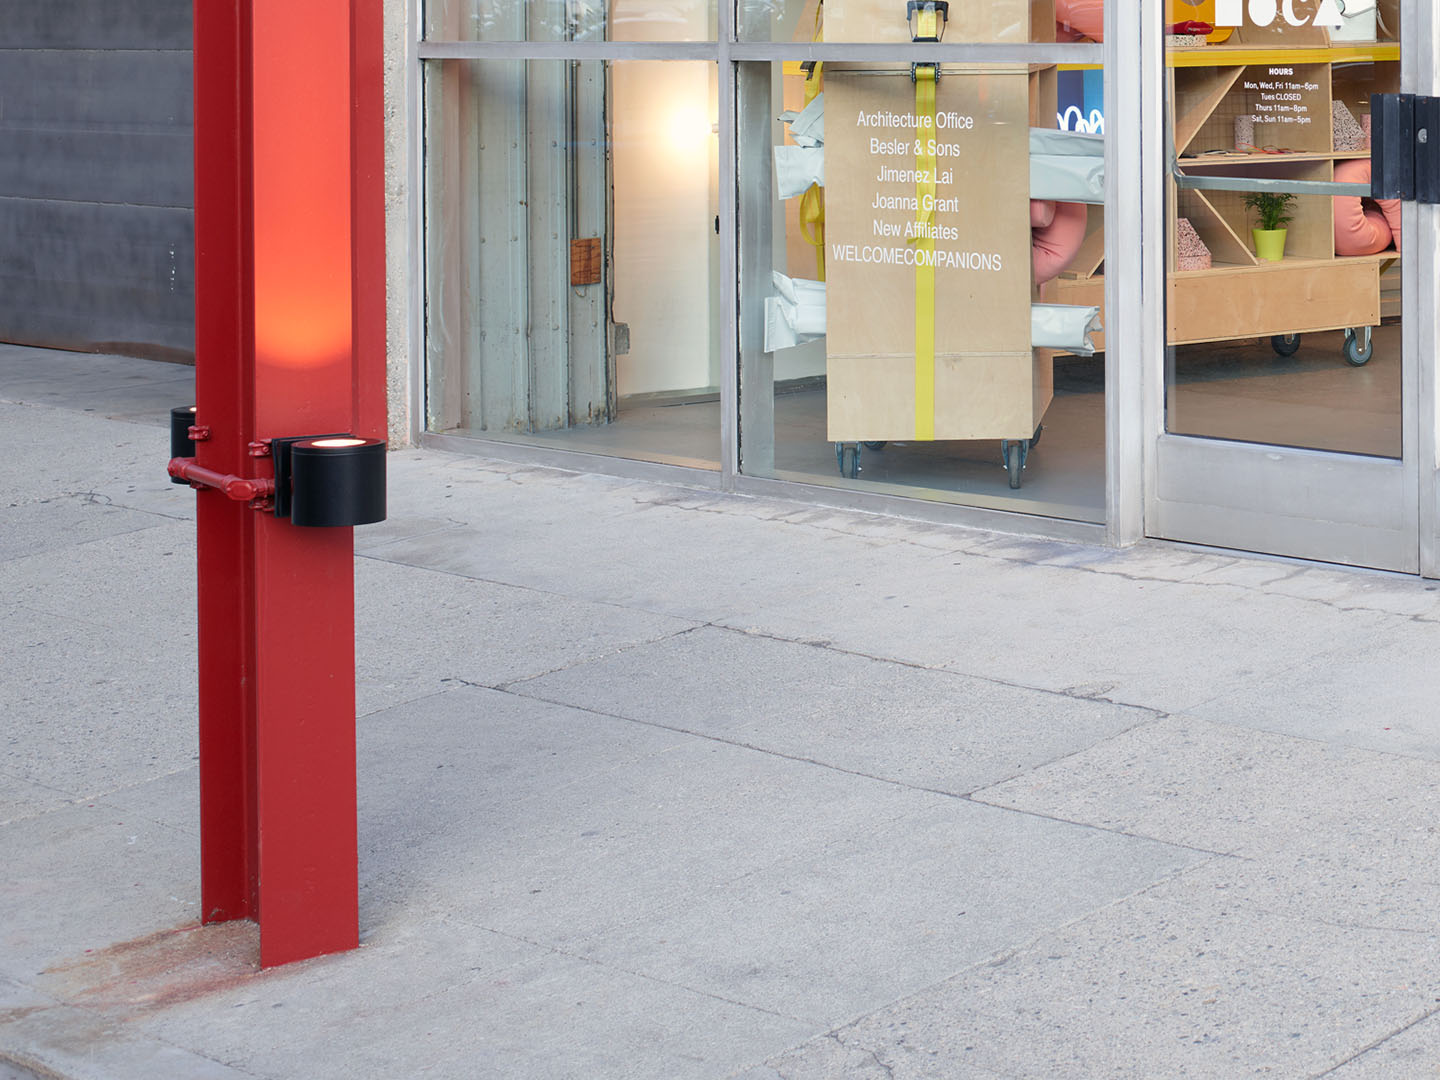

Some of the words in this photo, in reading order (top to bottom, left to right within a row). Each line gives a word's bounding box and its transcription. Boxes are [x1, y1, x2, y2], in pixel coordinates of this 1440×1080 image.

[1268, 68, 1293, 76] HOURS
[1244, 81, 1259, 90] Mon,
[1259, 82, 1274, 90] Wed,
[1261, 93, 1275, 101] Tues
[1276, 93, 1301, 101] CLOSED
[1255, 104, 1273, 112] Thurs
[856, 110, 932, 128] Architecture
[935, 112, 974, 129] Office
[1251, 114, 1263, 124] Sat,
[1264, 115, 1277, 123] Sun
[870, 137, 910, 155] Besler
[913, 139, 924, 156] &
[927, 139, 961, 157] Sons
[877, 166, 930, 184] Jimenez
[934, 168, 953, 185] Lai
[872, 192, 918, 210] Joanna
[922, 194, 959, 212] Grant
[873, 220, 901, 237] New
[904, 221, 959, 240] Affiliates
[832, 244, 1002, 271] WELCOMECOMPANIONS
